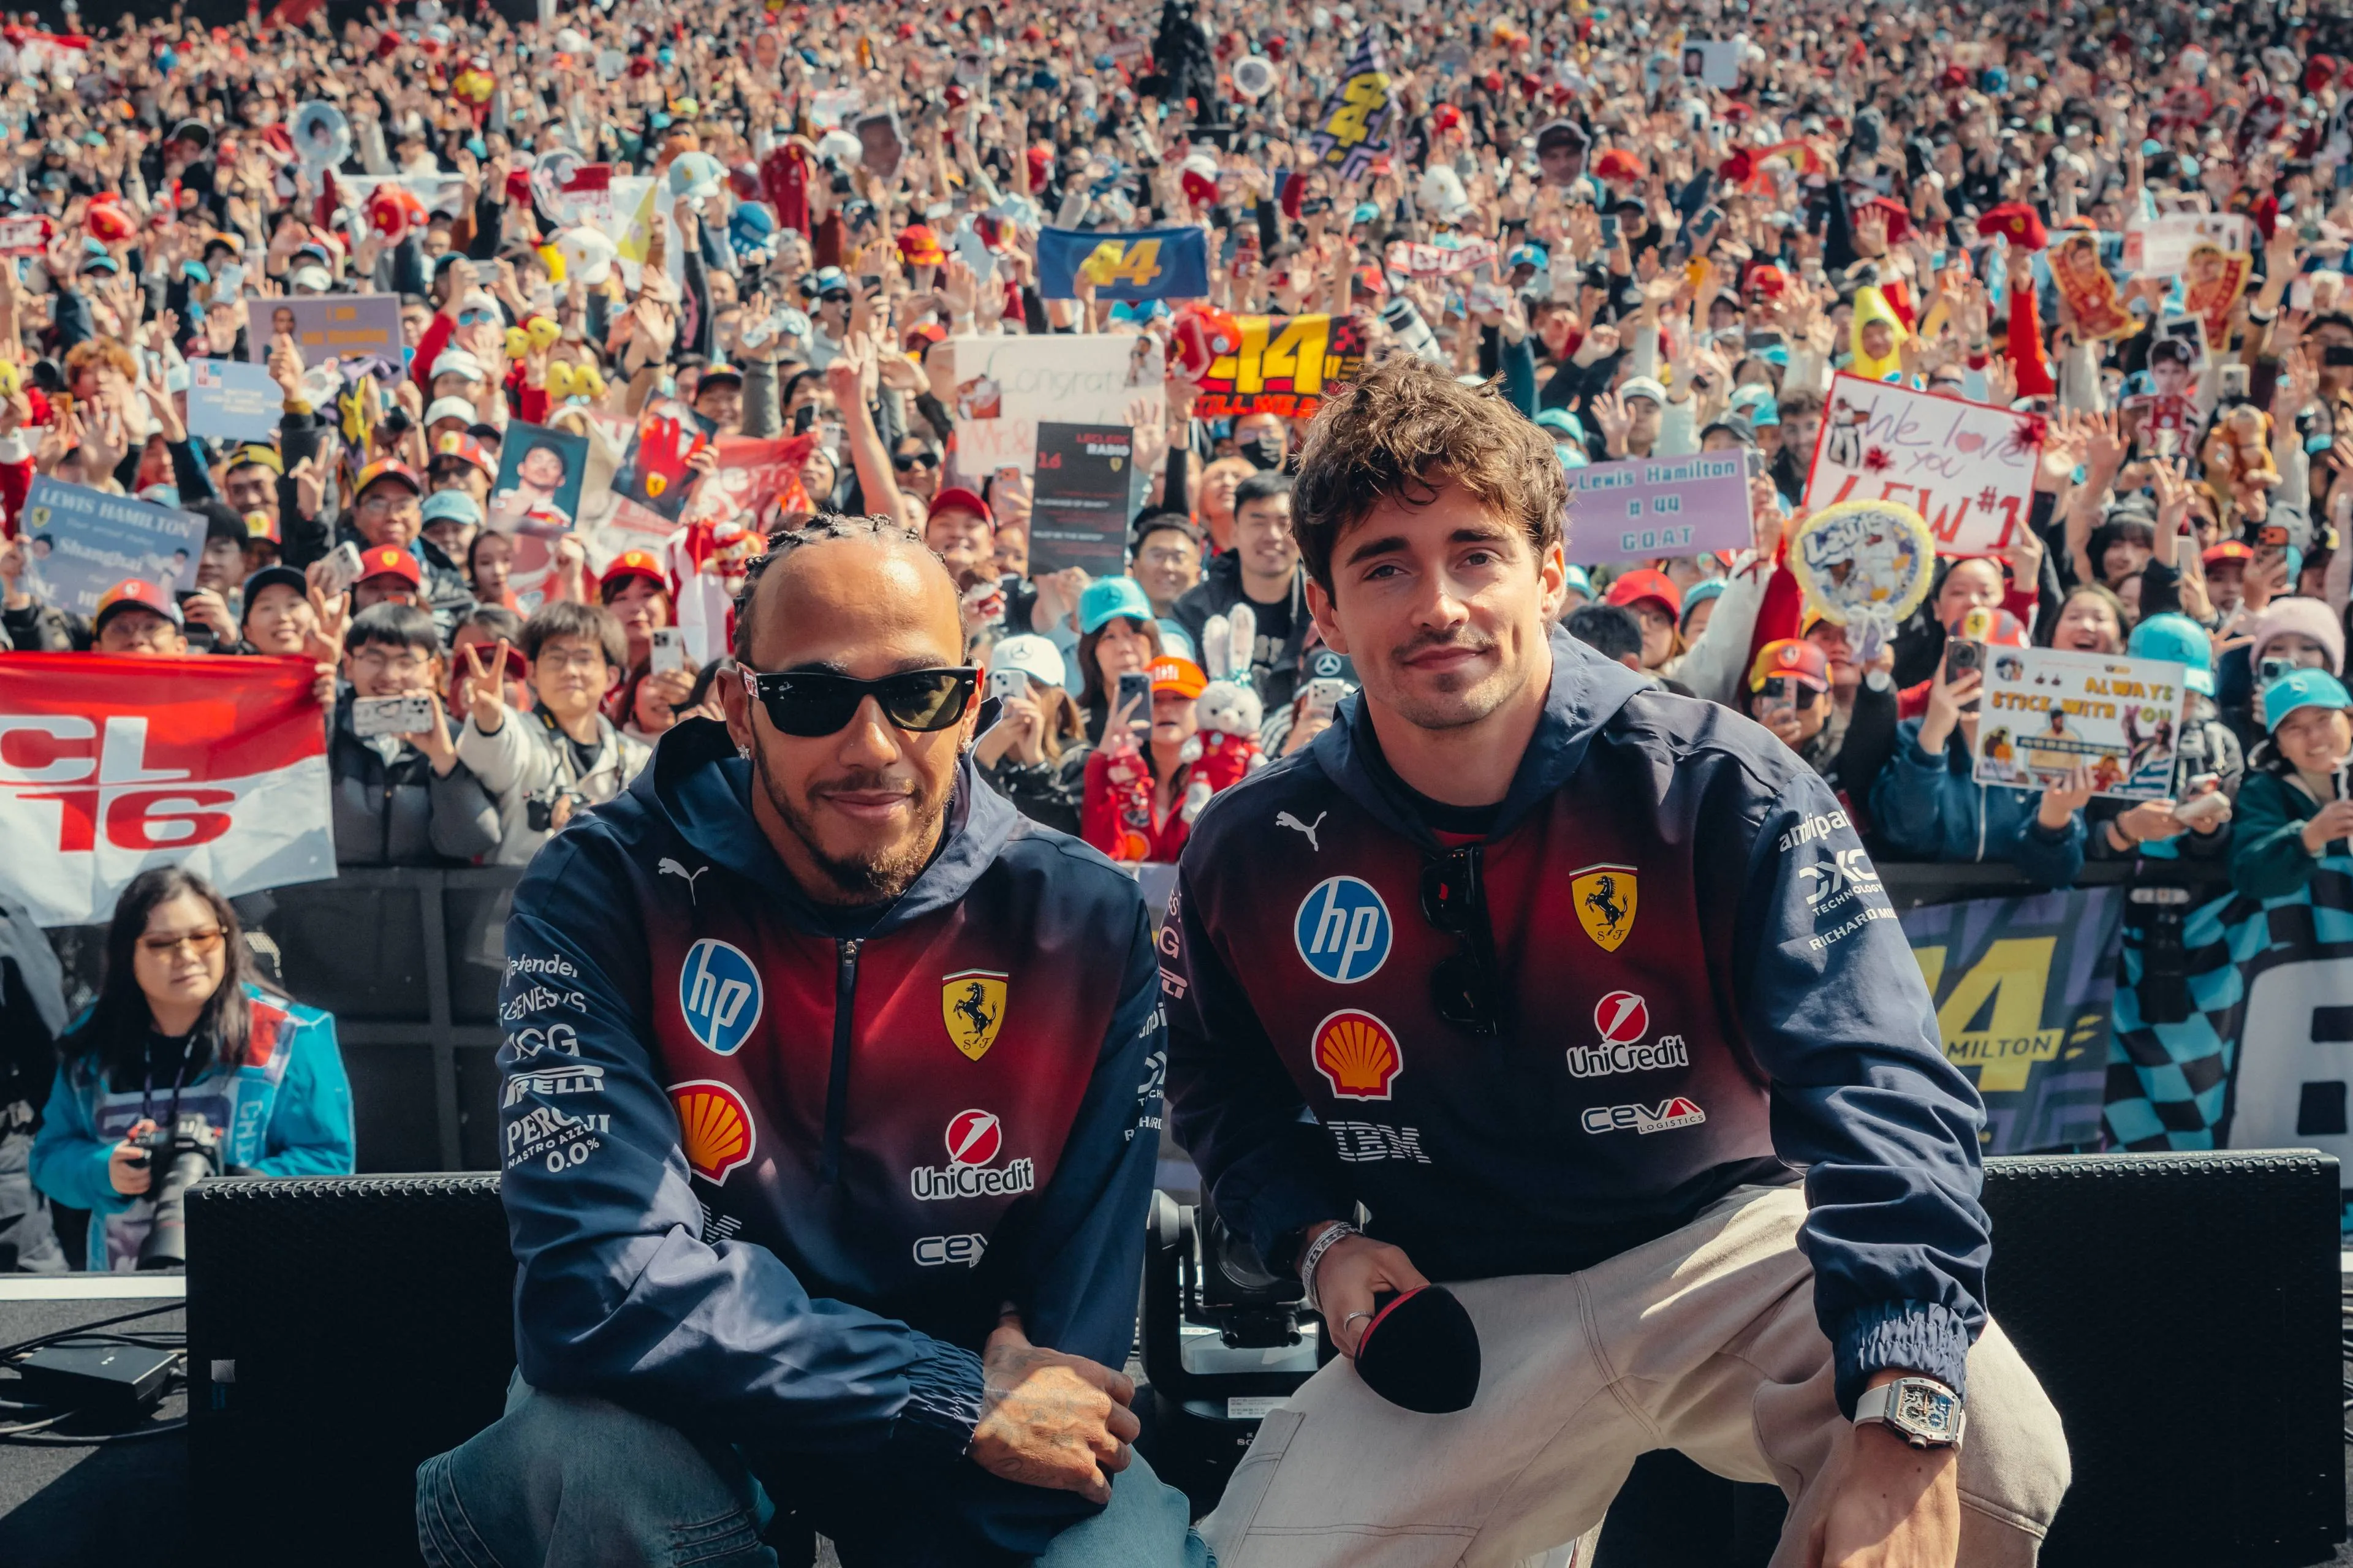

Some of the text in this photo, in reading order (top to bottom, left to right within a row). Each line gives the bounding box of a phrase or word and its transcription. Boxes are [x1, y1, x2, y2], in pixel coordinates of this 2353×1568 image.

[1037, 451, 1062, 469] 16
[1578, 460, 1737, 491] Lewis Hamilton
[39, 487, 97, 515] LEWIS
[99, 502, 192, 538] HAMILTON
[0, 715, 191, 784] CL
[15, 789, 236, 852] 16
[1812, 883, 1884, 917] TECHNOLOGY
[1309, 877, 1380, 982] hp
[1808, 908, 1878, 950] RICHARD
[506, 953, 578, 988] efende
[687, 937, 753, 1050] hp
[1910, 936, 2058, 1092] 4
[1569, 1037, 1687, 1076] UniCredit
[502, 1065, 605, 1109] PRELLI
[1327, 1121, 1432, 1164] IBM
[1639, 1114, 1705, 1133] LOGISTICS
[508, 1138, 556, 1170] NASTRO
[546, 1137, 600, 1173] 0.0%
[914, 1160, 1033, 1198] UniCredit
